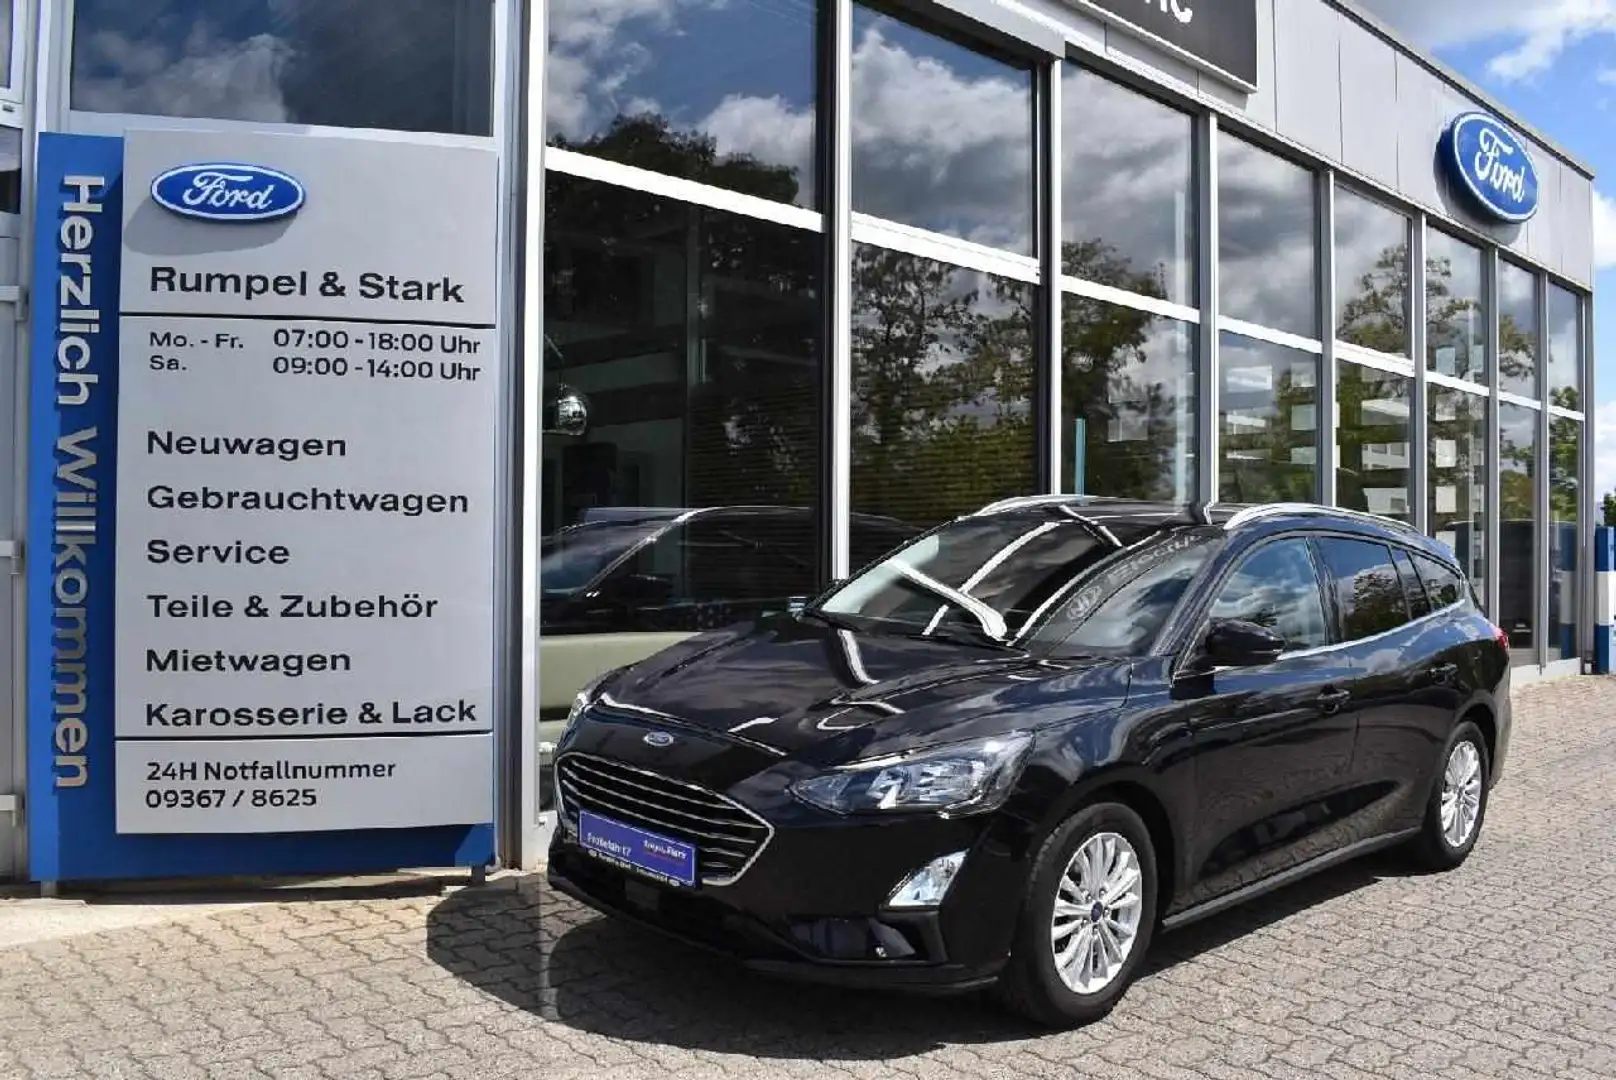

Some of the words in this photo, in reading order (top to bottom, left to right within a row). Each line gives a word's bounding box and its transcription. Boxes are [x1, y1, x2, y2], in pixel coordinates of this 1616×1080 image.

[1474, 127, 1526, 203] Ford
[182, 171, 275, 210] Ford
[56, 175, 105, 405] Herzlich
[150, 266, 307, 300] Rumpel
[318, 271, 346, 297] &
[359, 272, 465, 304] Stark
[149, 331, 195, 348] Mo.
[214, 333, 244, 349] Fr.
[273, 328, 349, 349] 07:00
[440, 335, 481, 354] Uhr
[149, 354, 187, 371] Sa.
[272, 356, 349, 377] 09:00
[440, 362, 481, 381] Uhr
[147, 430, 346, 462] Neuwagen
[147, 484, 468, 517] Gebrauchtwagen
[147, 539, 290, 565] Service
[55, 426, 97, 788] Willkommen
[146, 594, 234, 618] Teile
[243, 594, 270, 618] &
[280, 593, 438, 618] Zubehör
[146, 648, 351, 678] Mietwagen
[146, 702, 348, 728] Karosserie
[358, 701, 383, 725] &
[392, 699, 477, 724] Lack
[146, 760, 198, 781] 24H
[204, 760, 396, 781] Notfallnummer
[145, 789, 227, 809] 09367
[232, 789, 246, 808] /
[250, 788, 317, 808] 8625
